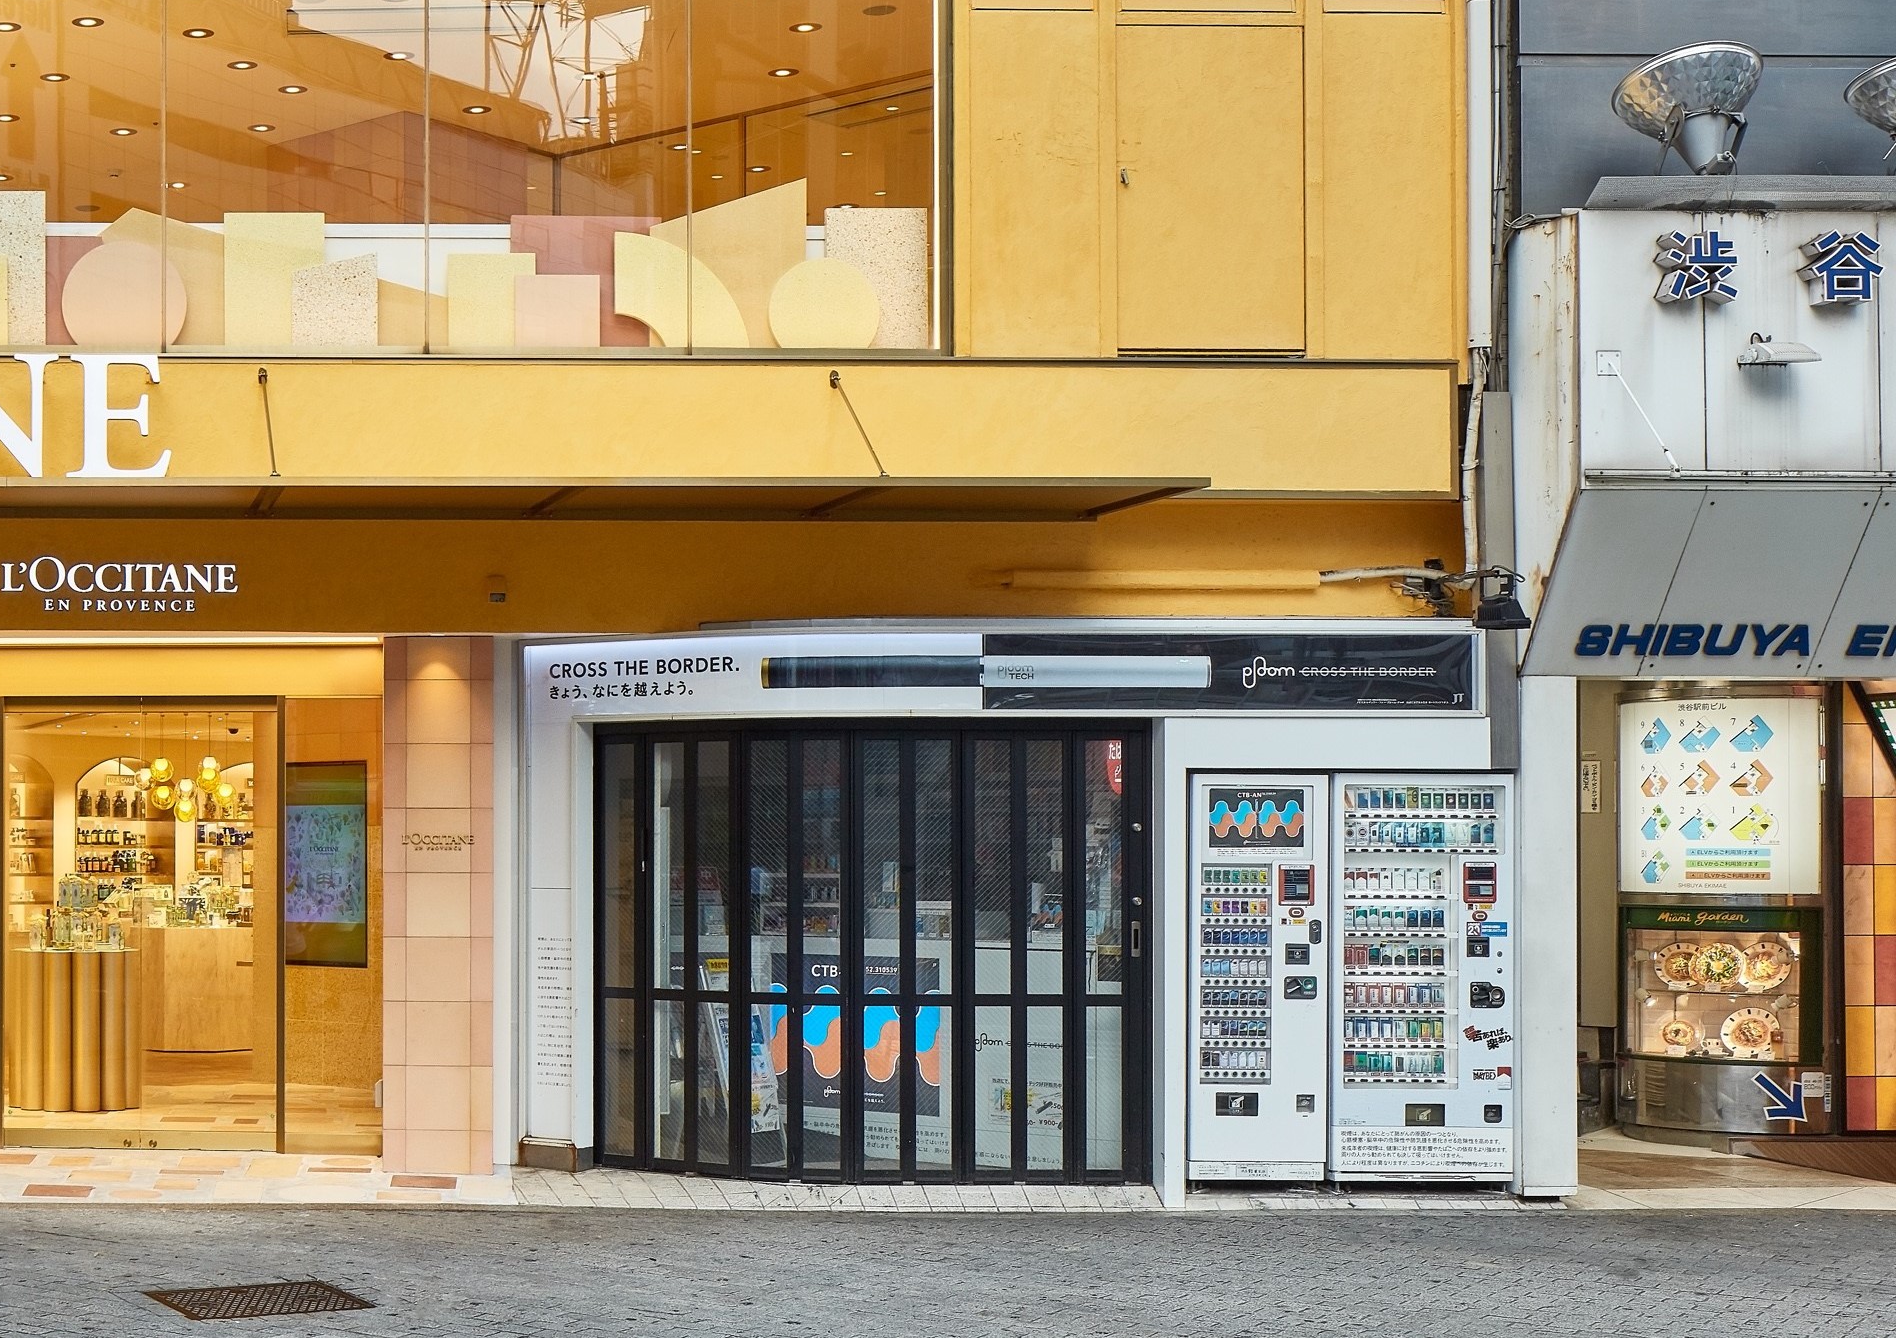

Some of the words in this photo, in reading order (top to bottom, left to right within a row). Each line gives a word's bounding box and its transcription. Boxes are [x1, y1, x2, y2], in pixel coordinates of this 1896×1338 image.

[1662, 227, 1885, 304] 渋谷
[0, 555, 239, 594] L'OCCITANE
[44, 598, 70, 611] EN
[83, 598, 196, 612] PROVENCE
[1575, 624, 1810, 657] SHIBUYA
[549, 662, 608, 679] CROSS
[614, 660, 649, 676] THE
[656, 656, 740, 675] BORDER.
[1242, 656, 1295, 689] ploom
[549, 681, 694, 700] きょう、なにを越えよう。
[1677, 702, 1727, 712] 渋谷駅前ビル
[1657, 912, 1692, 923] Miami
